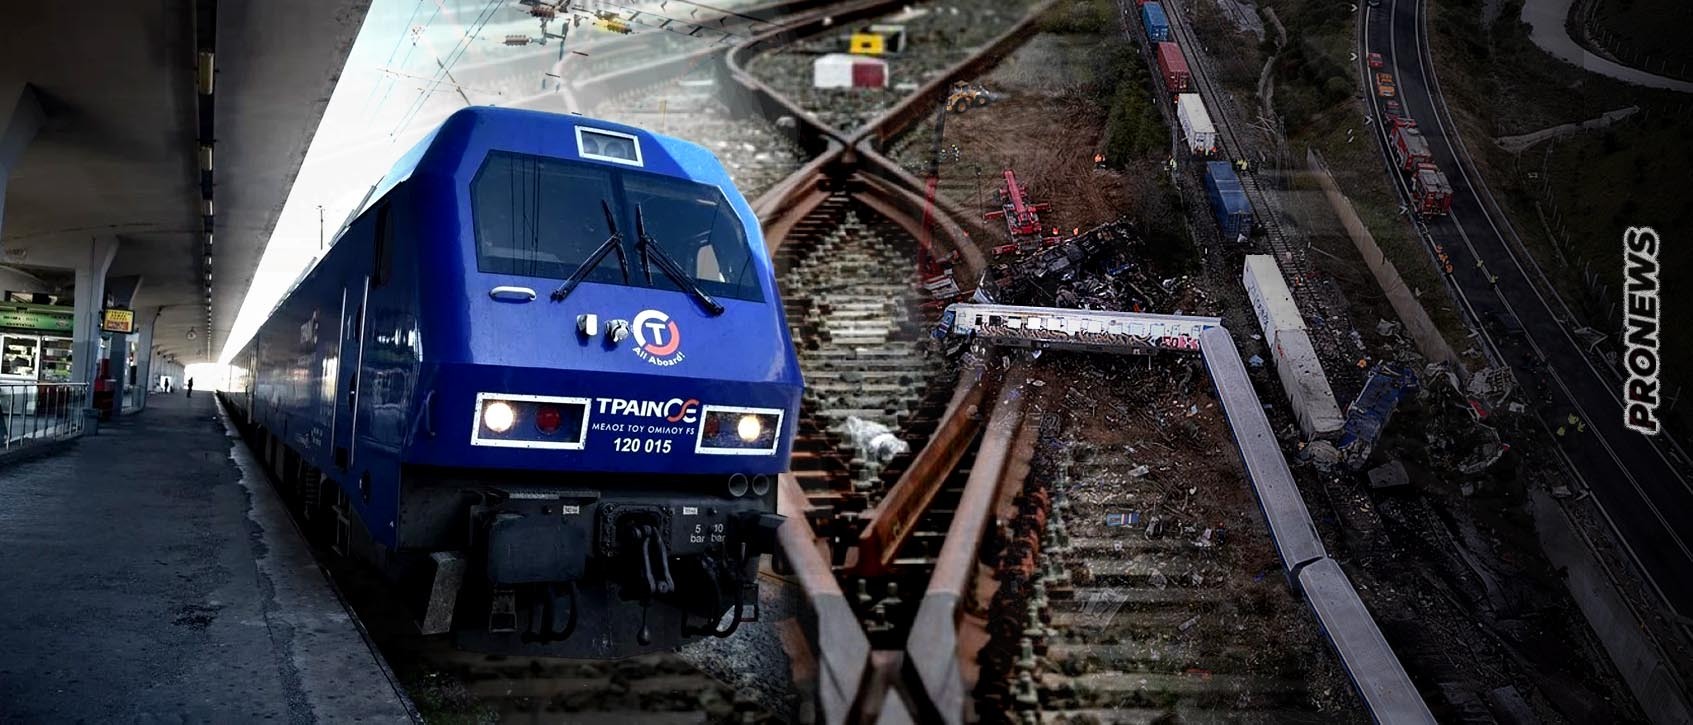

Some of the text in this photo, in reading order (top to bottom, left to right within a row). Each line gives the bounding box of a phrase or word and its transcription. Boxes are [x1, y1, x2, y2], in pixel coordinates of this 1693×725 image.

[632, 346, 686, 367] All Aboard!
[613, 437, 673, 454] 120 015
[695, 524, 702, 534] 5
[714, 523, 725, 533] 10
[690, 533, 705, 544] bar
[711, 532, 726, 543] bar
